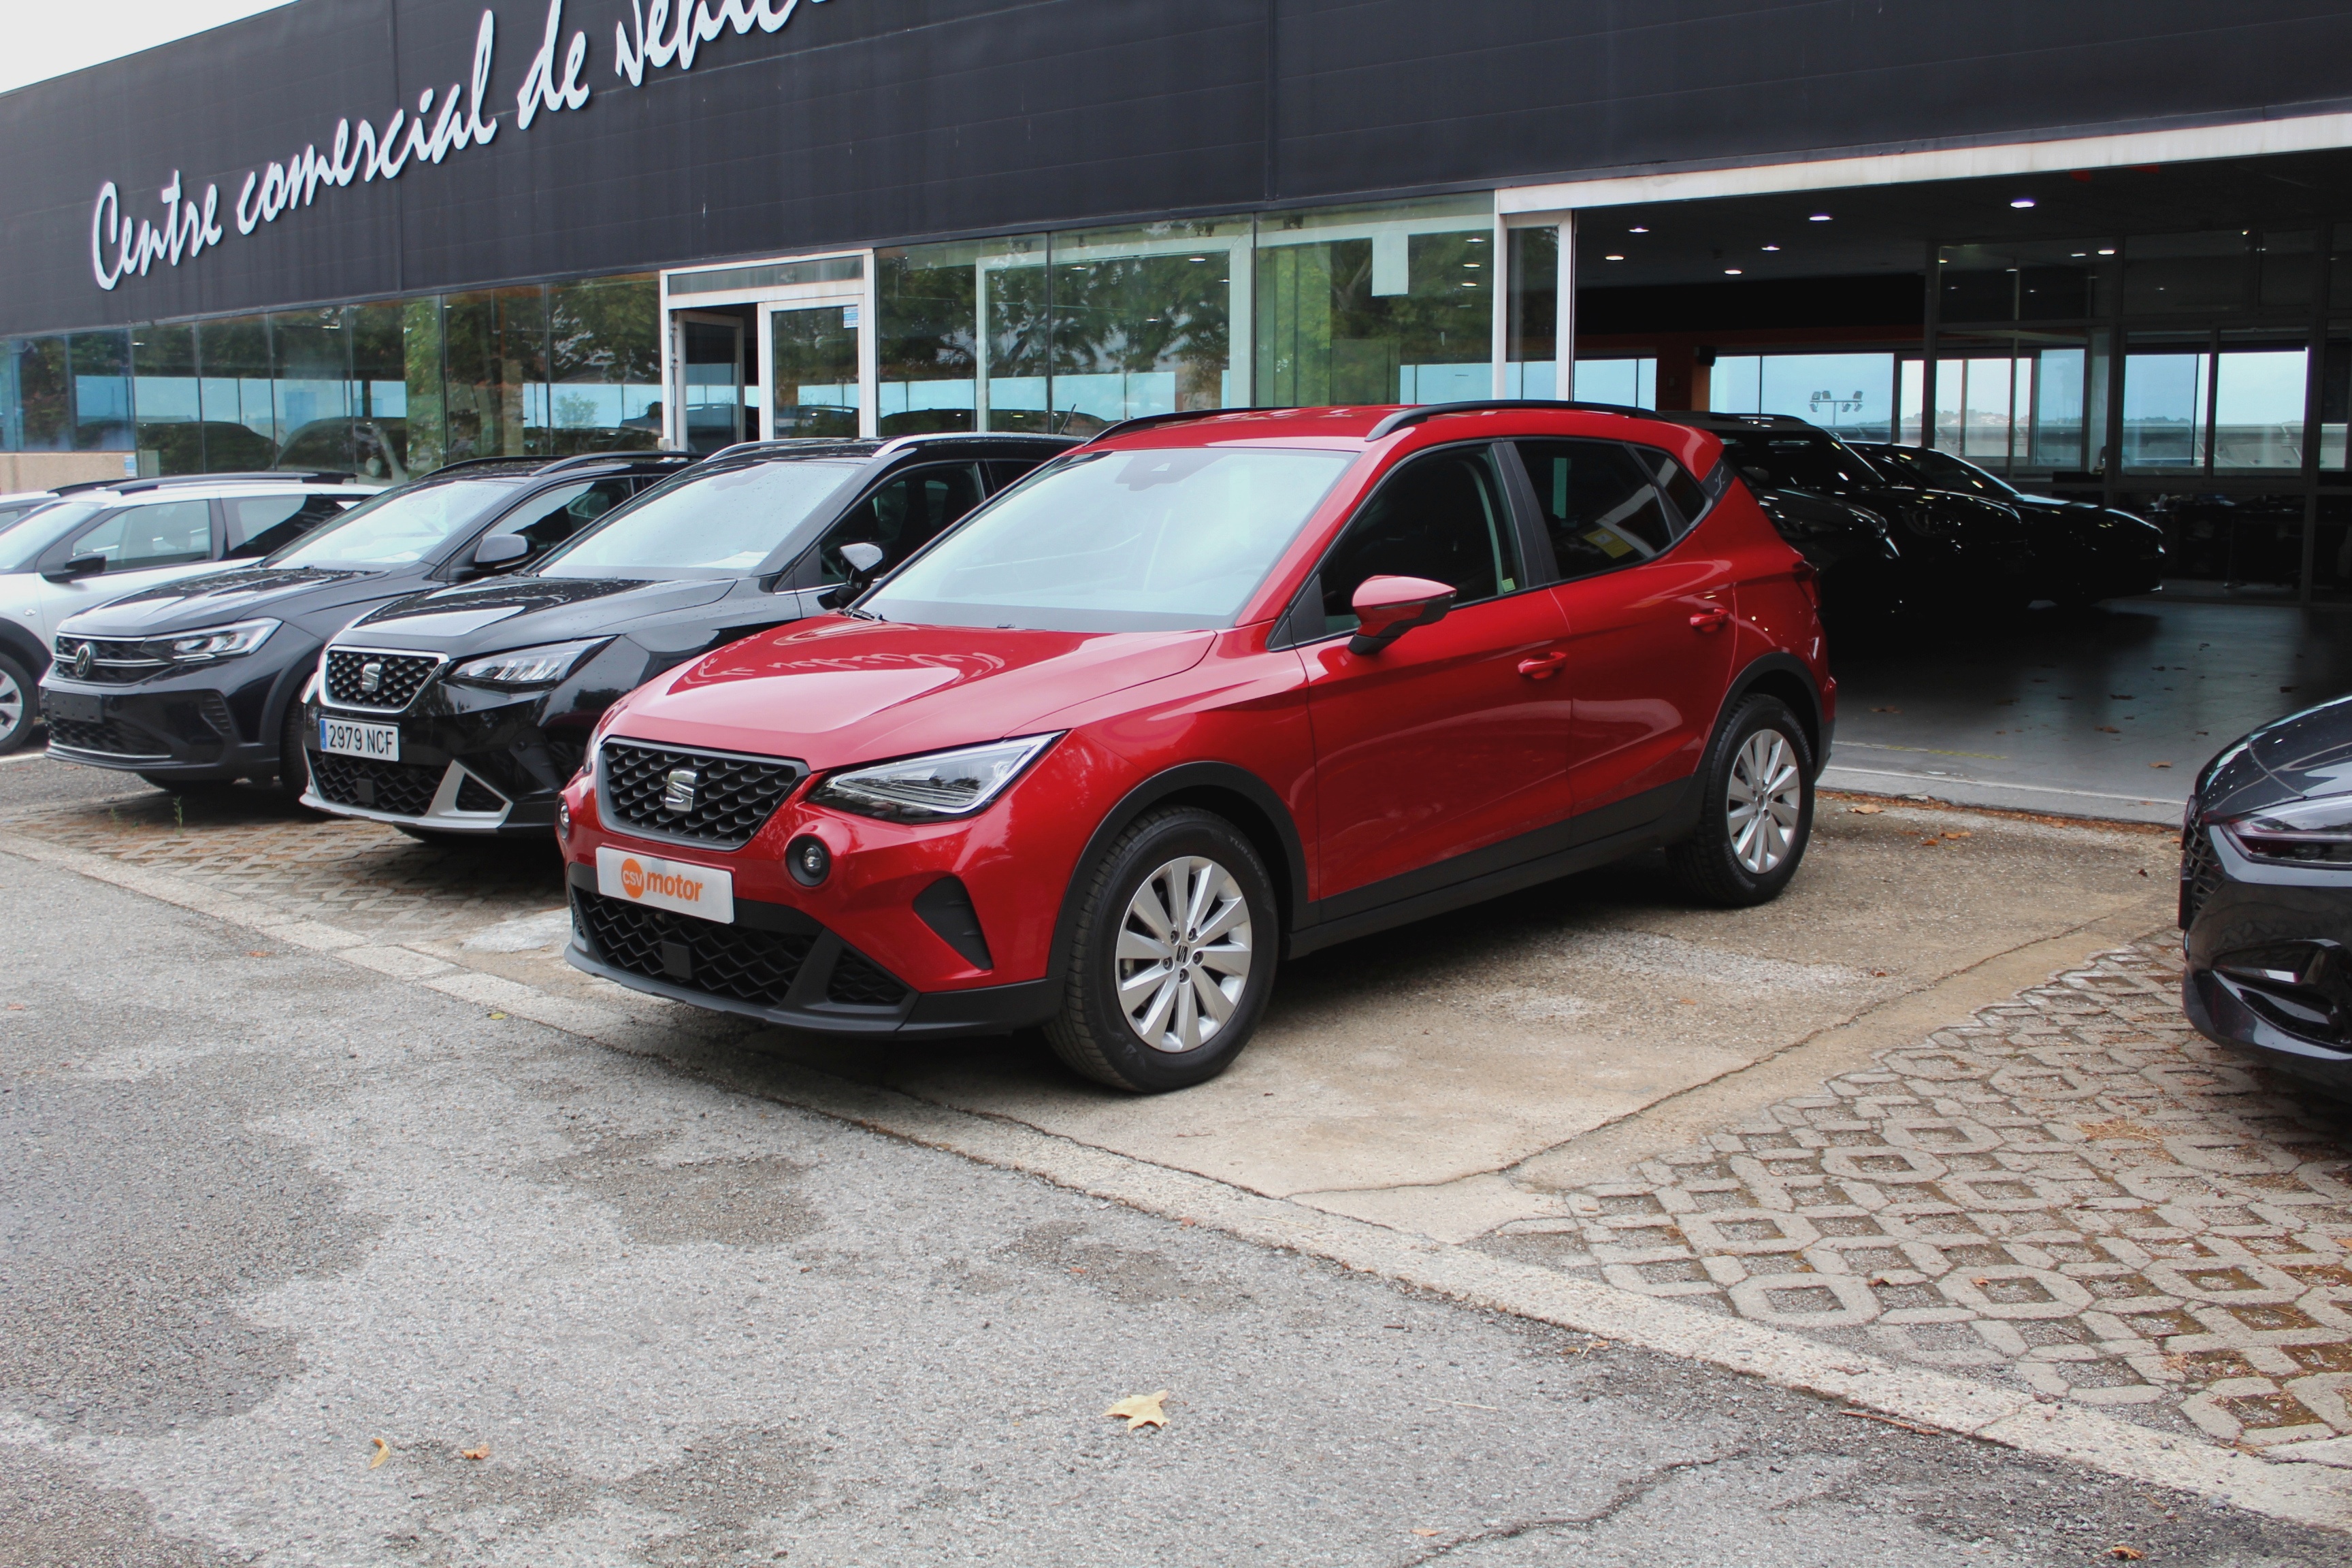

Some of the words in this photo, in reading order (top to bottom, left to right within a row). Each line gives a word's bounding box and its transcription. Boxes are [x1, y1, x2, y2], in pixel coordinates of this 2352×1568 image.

[91, 169, 223, 291] Centre
[235, 9, 498, 235] comercial
[517, 0, 590, 131] de
[329, 724, 363, 751] 2979
[366, 728, 394, 755] NCF
[621, 870, 643, 886] CSV
[647, 870, 704, 902] motor
